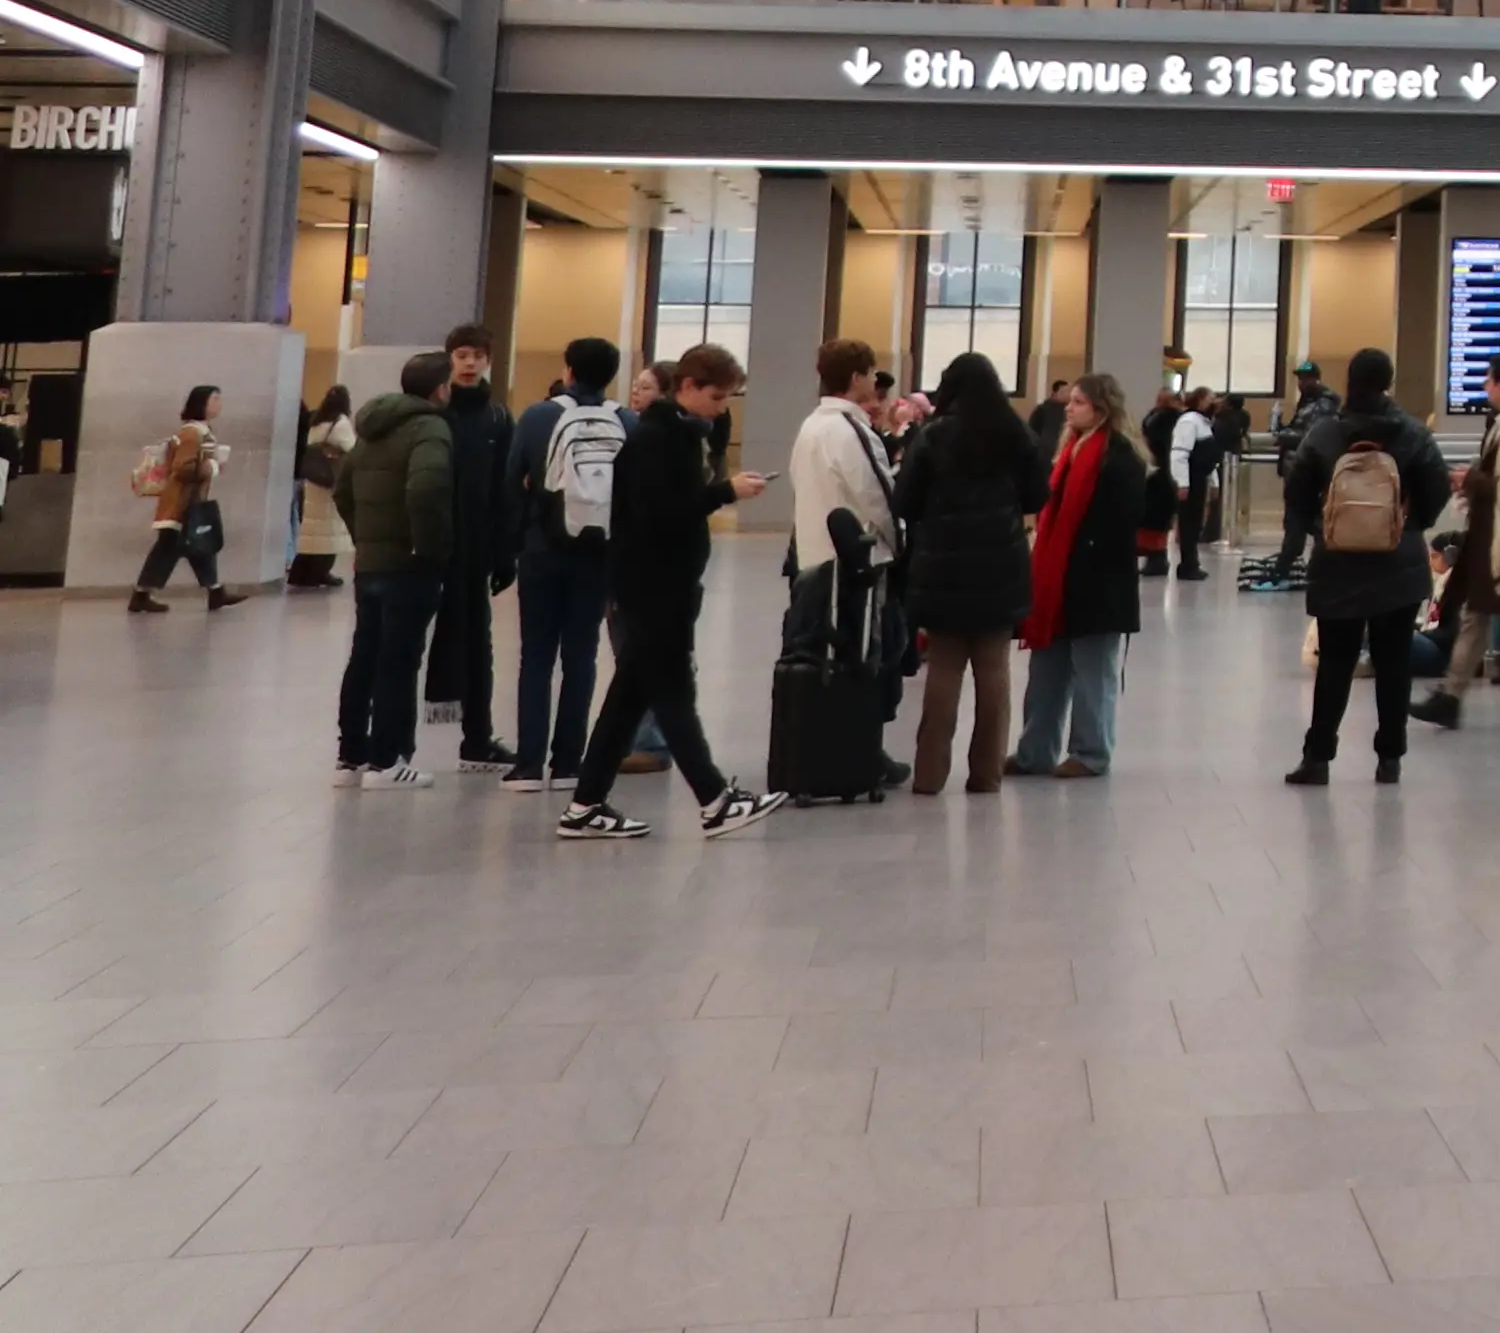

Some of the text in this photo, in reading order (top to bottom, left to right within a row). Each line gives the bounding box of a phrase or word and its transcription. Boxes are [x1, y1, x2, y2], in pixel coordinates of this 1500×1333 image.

[904, 48, 1440, 101] 8th Avenue & 31st Street
